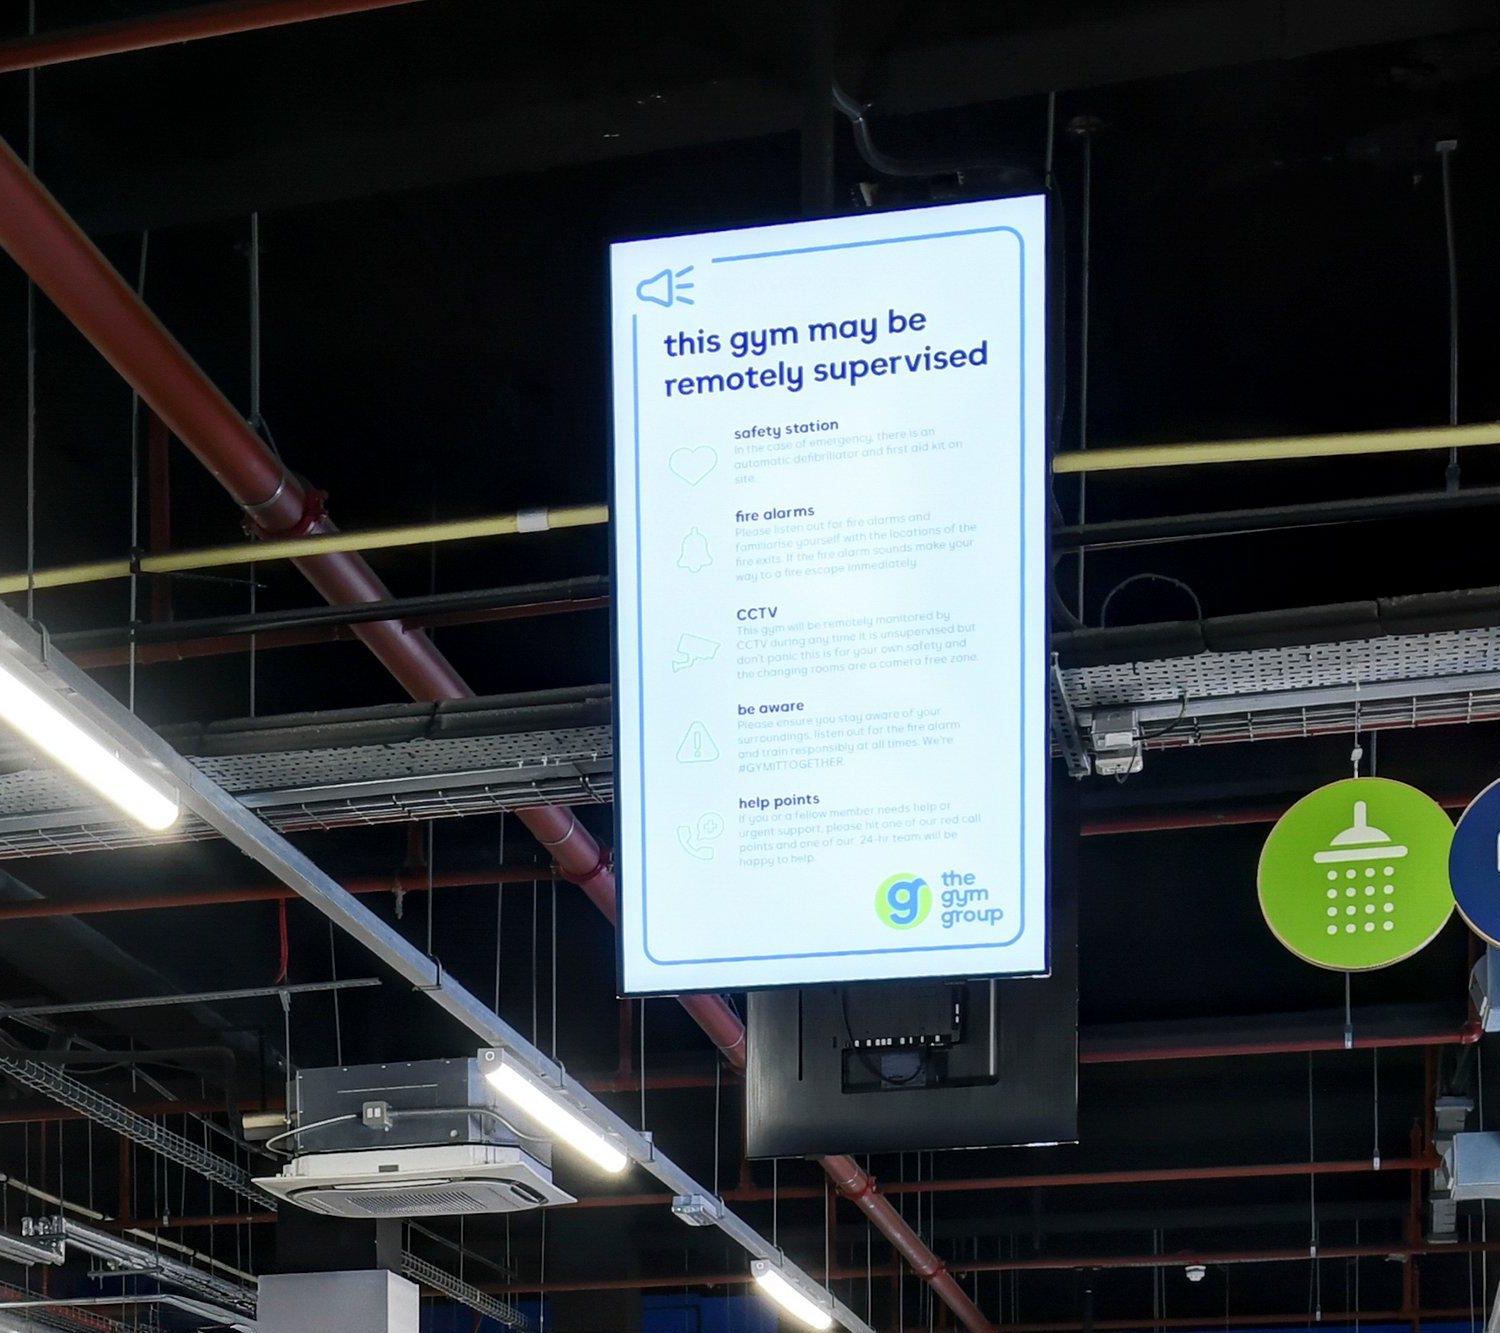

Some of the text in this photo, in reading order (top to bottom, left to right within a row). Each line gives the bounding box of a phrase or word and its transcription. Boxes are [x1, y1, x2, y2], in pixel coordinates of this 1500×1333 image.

[664, 310, 926, 357] this gym may be
[665, 340, 988, 396] remotely supervised
[735, 420, 838, 439] safety station
[736, 506, 814, 522] fire alarms
[737, 606, 777, 621] CCTV
[737, 637, 768, 649] CCTV
[738, 702, 804, 715] be aware
[739, 794, 820, 810] help points
[941, 870, 976, 887] the
[941, 888, 989, 908] gym
[941, 905, 1004, 929] group
